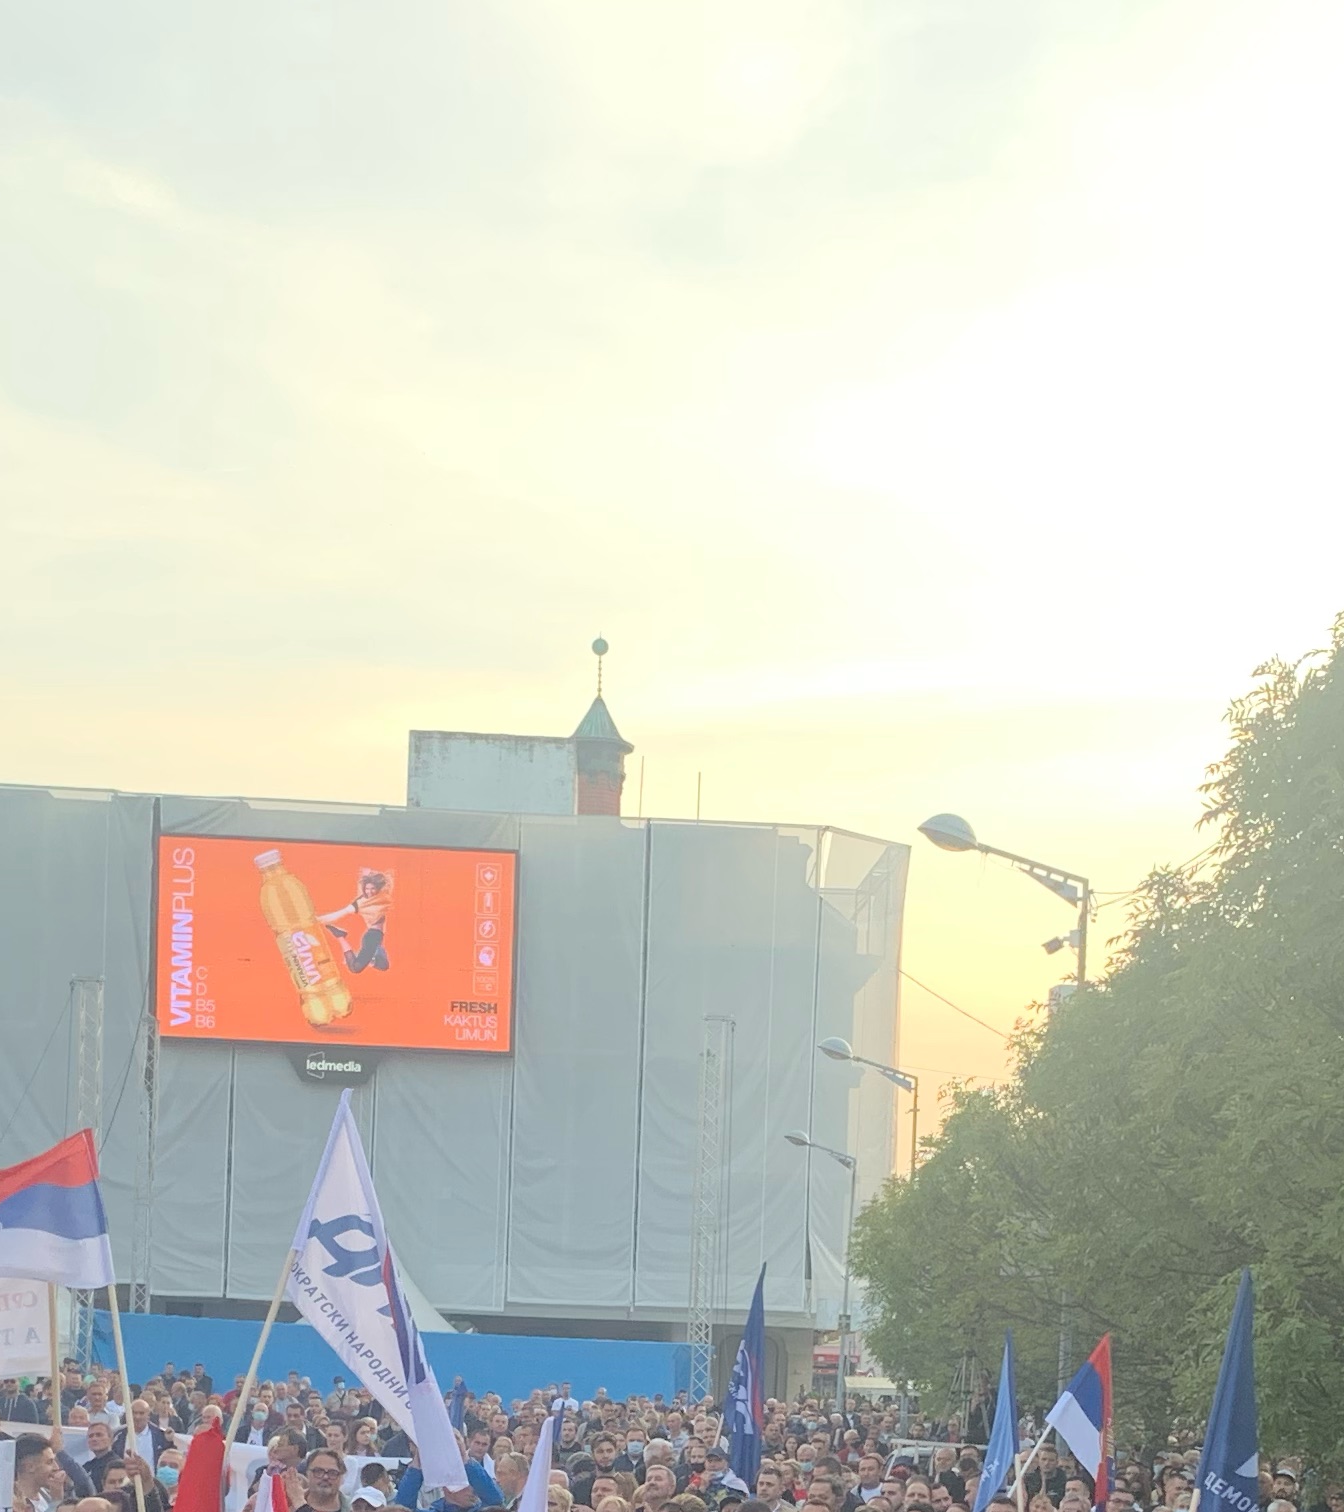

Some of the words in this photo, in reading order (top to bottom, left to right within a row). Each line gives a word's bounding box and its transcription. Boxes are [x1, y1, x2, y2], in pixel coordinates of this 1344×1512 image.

[450, 1001, 498, 1014] FRESH
[196, 1015, 216, 1029] B6
[444, 1014, 497, 1029] KAKTUS
[455, 1028, 497, 1041] LIMUN
[306, 1059, 362, 1073] ledmedia
